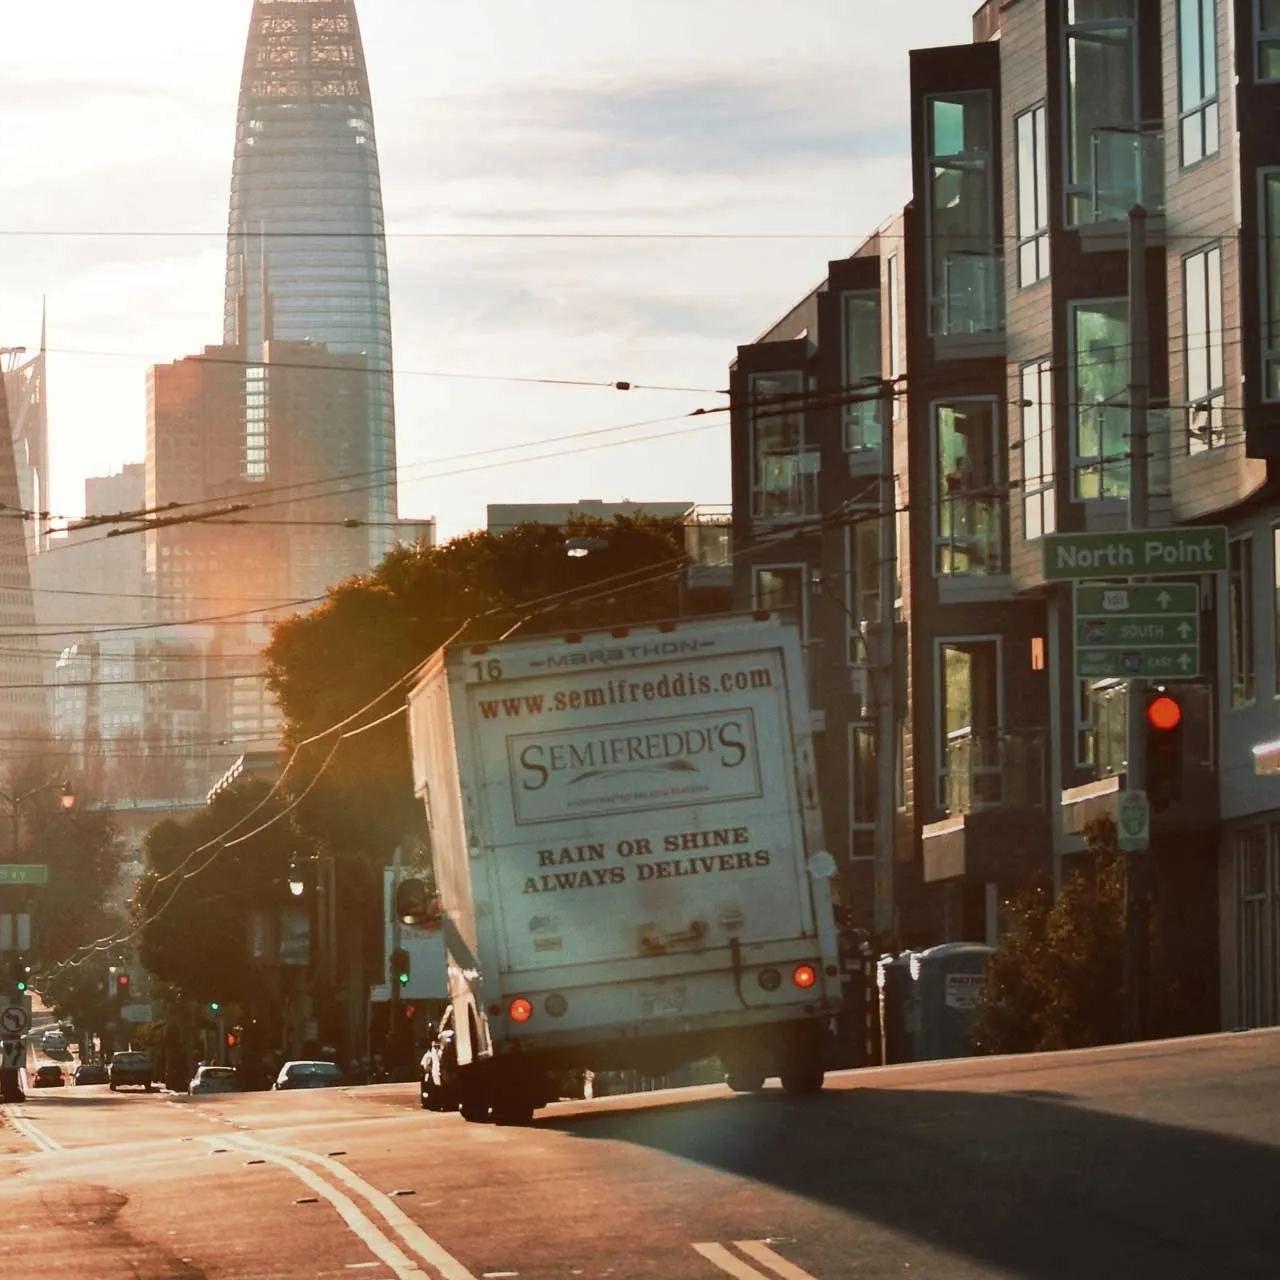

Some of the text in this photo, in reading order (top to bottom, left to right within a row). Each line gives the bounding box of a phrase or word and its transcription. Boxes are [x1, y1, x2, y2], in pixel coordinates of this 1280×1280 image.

[1056, 538, 1213, 569] North Point
[1120, 624, 1165, 639] SOUTH
[472, 659, 502, 681] 16
[1147, 657, 1173, 668] EAST
[479, 667, 773, 719] www.semifreddis.com
[519, 721, 747, 791] SEMIFREDDI'S
[536, 826, 750, 867] RAIN OR SHINE
[522, 849, 771, 894] ALWAYS DELIVERS
